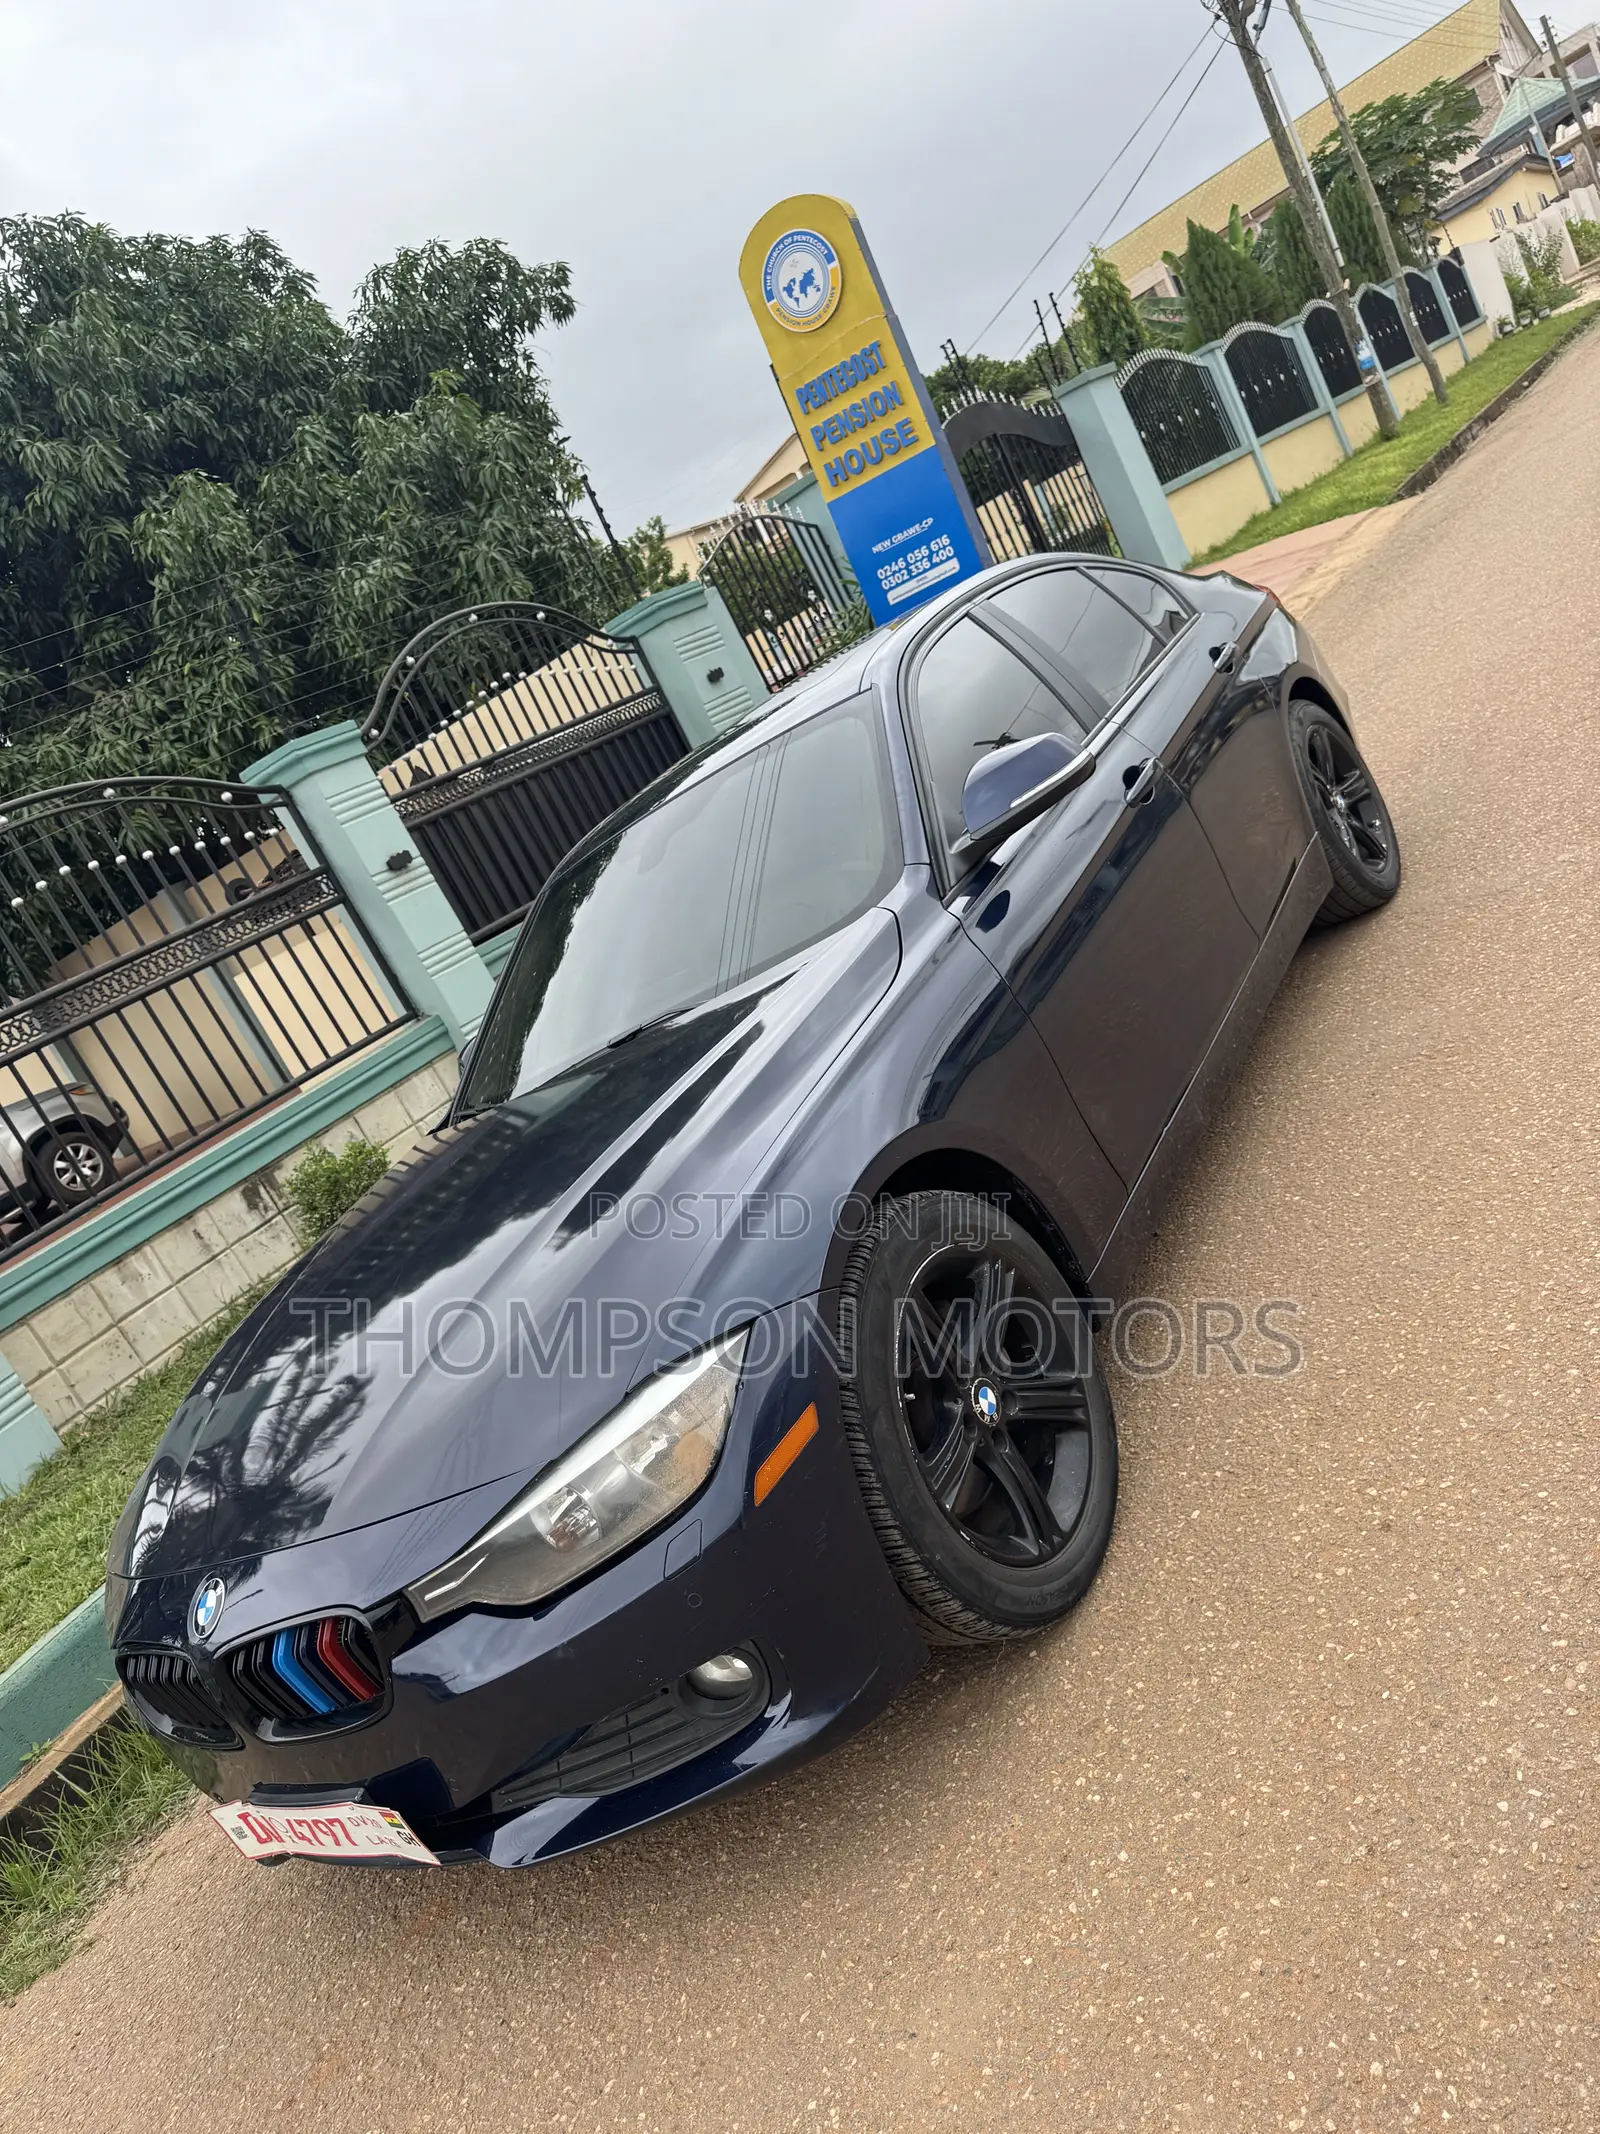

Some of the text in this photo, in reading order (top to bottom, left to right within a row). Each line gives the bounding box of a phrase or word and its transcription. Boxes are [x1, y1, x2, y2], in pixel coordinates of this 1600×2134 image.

[764, 234, 829, 291] THE CHURCH OF PENTECOST
[795, 340, 887, 415] PENTECOST
[810, 381, 904, 451] PENSION
[823, 417, 919, 487] HOUSE
[871, 517, 934, 554] NEW GBAWE-CP
[876, 557, 906, 580] 0246
[906, 545, 929, 564] 056
[930, 534, 951, 552] 616
[881, 572, 910, 590] 0302
[909, 559, 931, 576] 336
[932, 546, 955, 564] 400
[285, 1817, 358, 1847] 4797
[396, 1830, 422, 1848] GH
